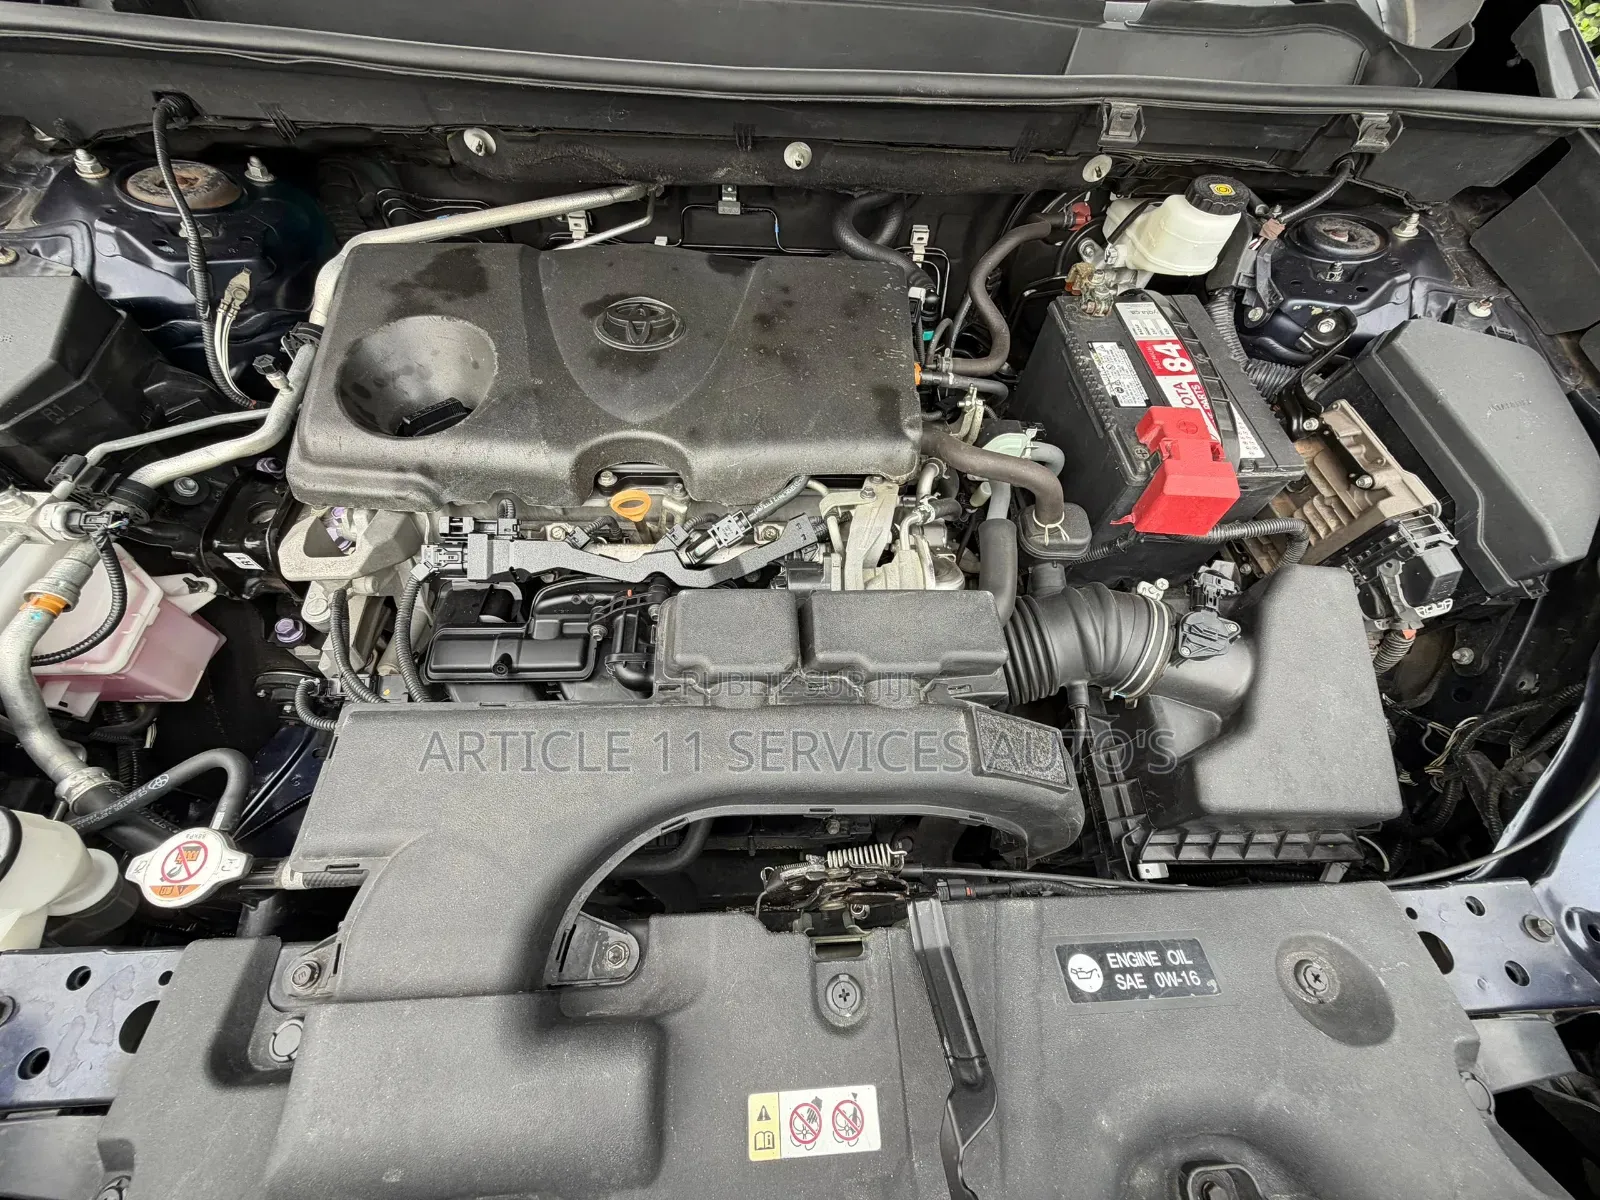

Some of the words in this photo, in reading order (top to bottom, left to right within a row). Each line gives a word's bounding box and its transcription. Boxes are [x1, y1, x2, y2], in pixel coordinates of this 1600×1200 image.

[1153, 342, 1194, 373] 84
[1173, 382, 1194, 408] OTA
[1190, 384, 1211, 410] PARTS
[1106, 951, 1162, 969] ENGINE
[1167, 949, 1194, 965] OIL
[1115, 973, 1148, 991] SAE
[1154, 970, 1202, 988] 0W-16
